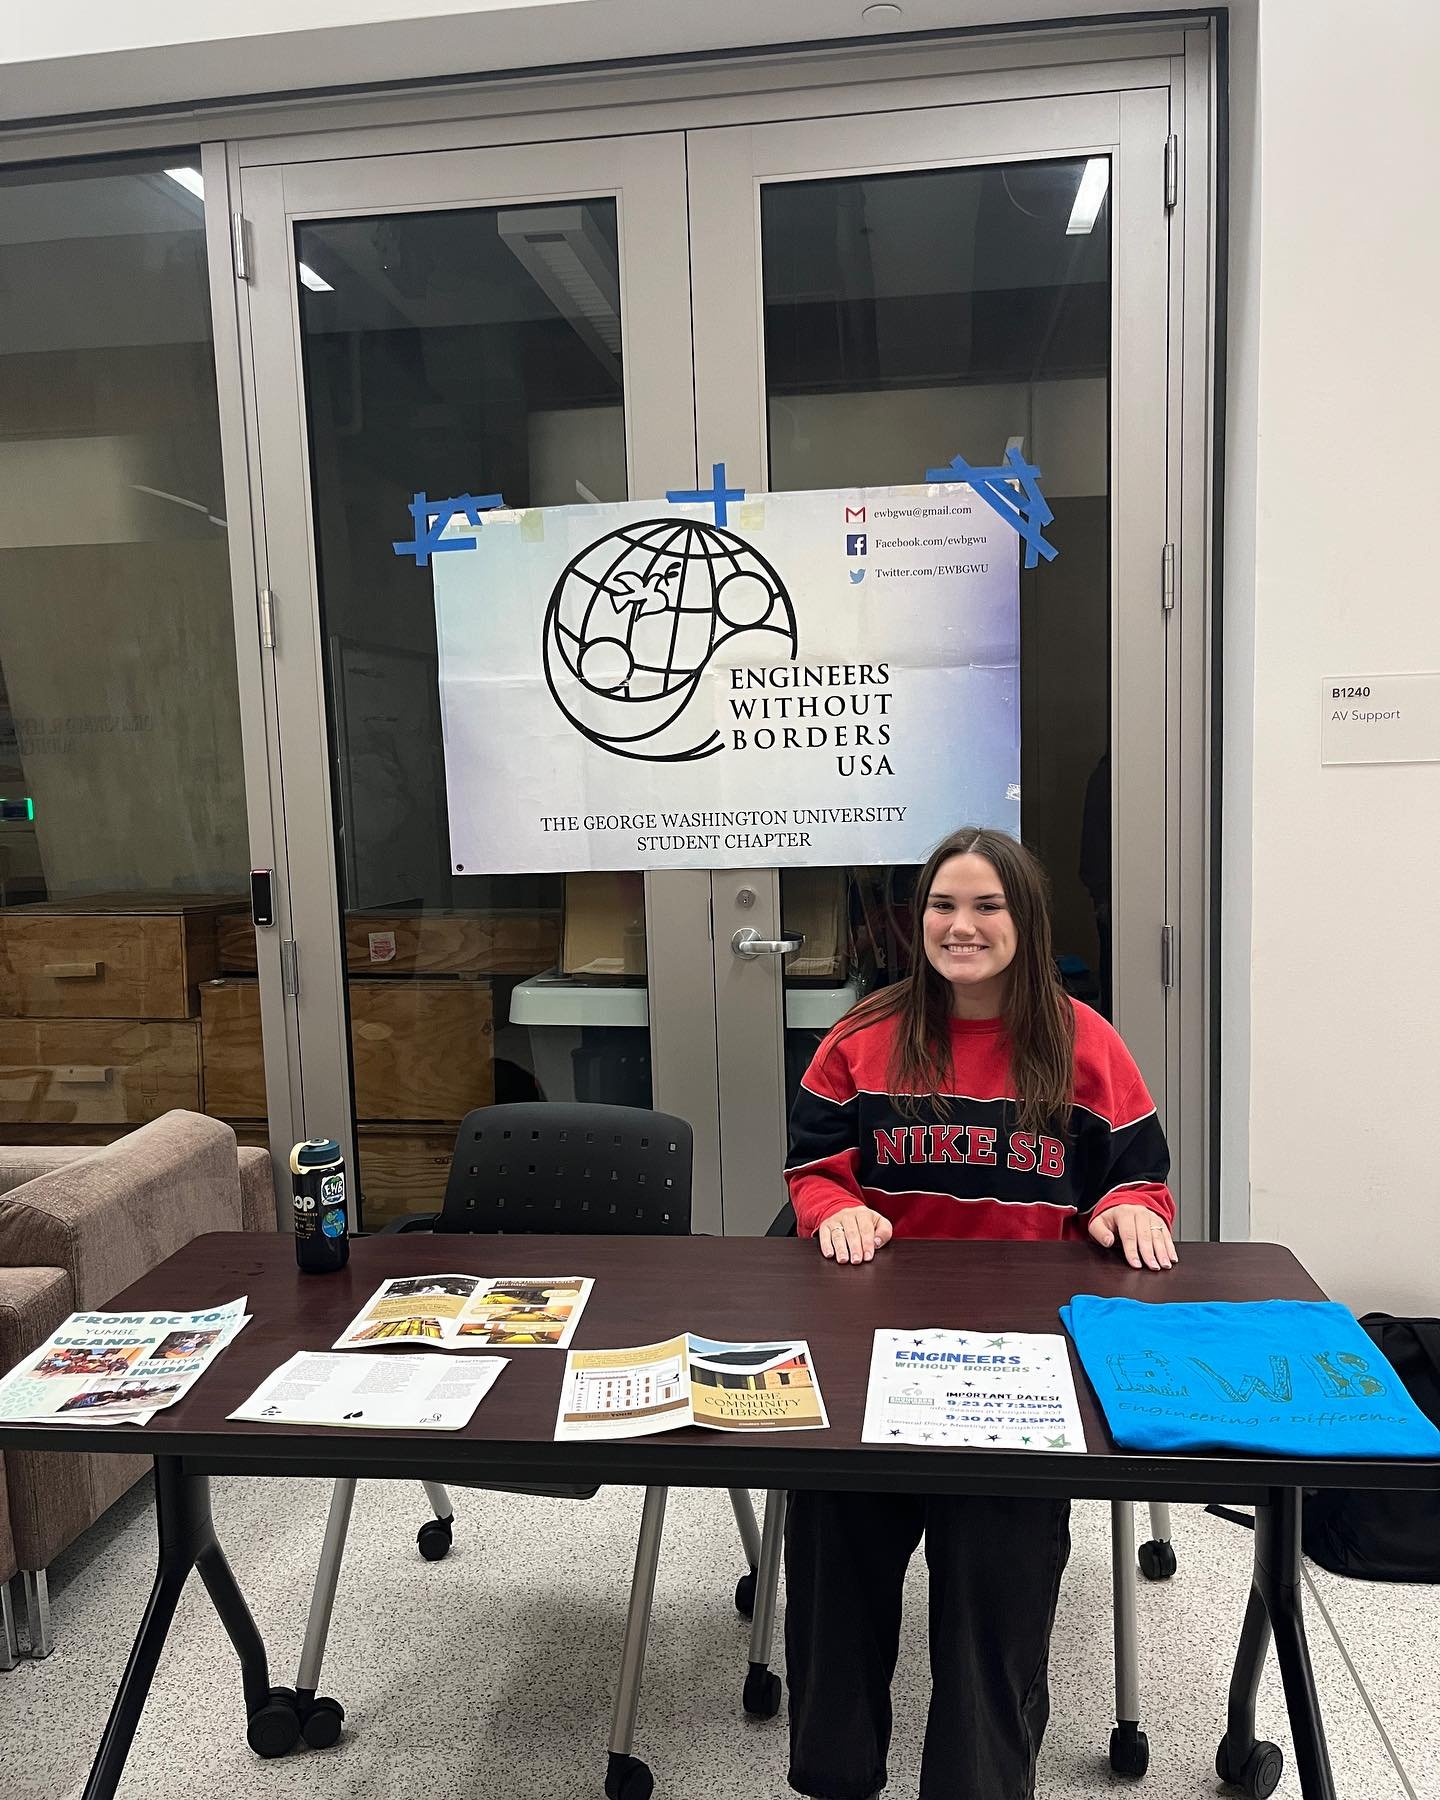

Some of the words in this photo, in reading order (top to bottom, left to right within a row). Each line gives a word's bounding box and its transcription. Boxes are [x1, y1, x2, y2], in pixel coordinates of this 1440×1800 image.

[874, 506, 972, 519] ewbgwu@gmail.com
[875, 535, 987, 548] Facebook.com/ewbgwu
[875, 564, 989, 578] Twitter.com/EWBGWU
[729, 663, 890, 689] ENGINEERS
[1332, 687, 1370, 698] B1240
[729, 693, 893, 720] WITHOUT
[1331, 710, 1348, 721] AV
[1351, 709, 1400, 723] Support
[732, 724, 891, 750] BORDERS
[836, 754, 896, 776] USA
[540, 816, 579, 832] THE
[583, 814, 658, 831] GEORGE
[661, 810, 788, 829] WASHINGTON
[793, 806, 907, 825] UNIVERSITY
[637, 836, 720, 851] STUDENT
[725, 832, 812, 849] CHAPTER
[873, 1124, 997, 1165] NIKE
[1007, 1131, 1065, 1178] SB
[72, 1315, 144, 1325] FROM
[149, 1316, 183, 1325] DC
[190, 1312, 239, 1324] TO...
[85, 1328, 139, 1336] YUMBE
[53, 1336, 156, 1346] UGANDA
[895, 1351, 1022, 1365] ENGINEERS
[129, 1363, 202, 1377] INDIA
[895, 1362, 958, 1371] WITHOUT
[963, 1365, 1031, 1373] BORDERS
[704, 1396, 801, 1408] COMMUNITY
[723, 1392, 782, 1401] YUMBE
[946, 1391, 1012, 1400] IMPORTANT
[947, 1400, 981, 1409] 9/23
[982, 1401, 1002, 1409] AT
[1007, 1402, 1063, 1410] 7:15PM
[720, 1407, 791, 1417] LIBRARY
[1118, 1401, 1260, 1427] Engineering
[945, 1414, 981, 1423] 9/30
[985, 1415, 1005, 1423] AT
[1008, 1416, 1065, 1424] 7:15PM
